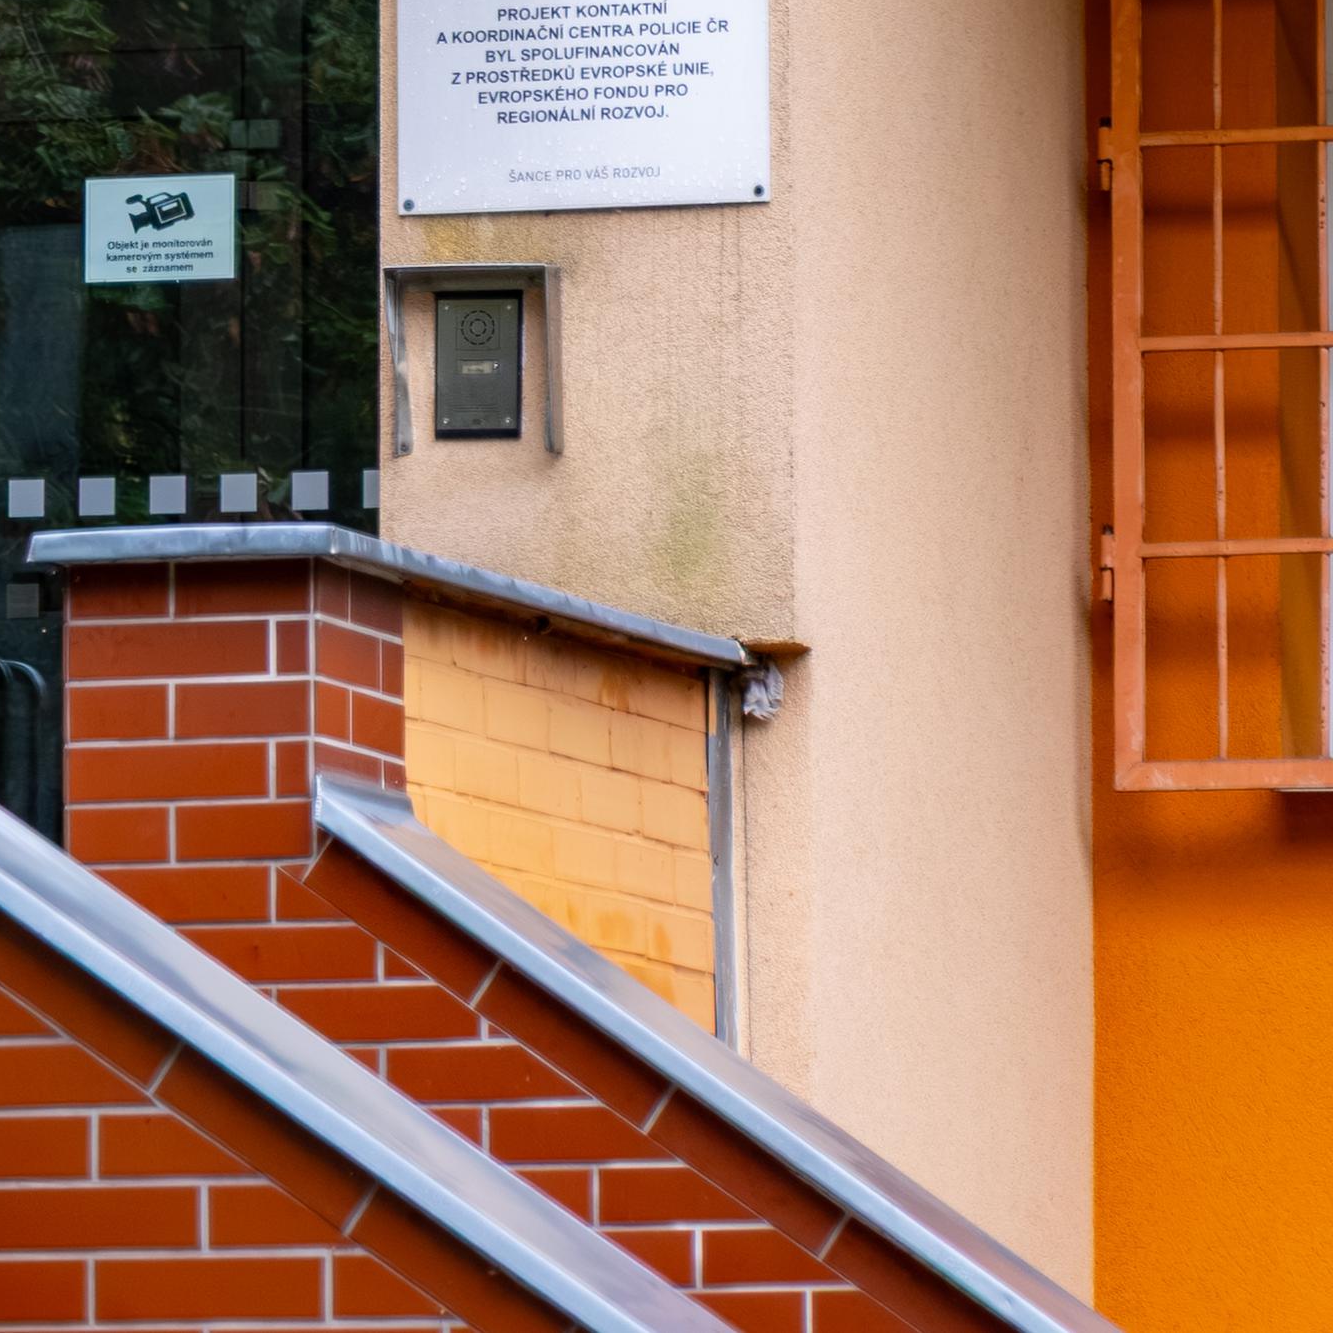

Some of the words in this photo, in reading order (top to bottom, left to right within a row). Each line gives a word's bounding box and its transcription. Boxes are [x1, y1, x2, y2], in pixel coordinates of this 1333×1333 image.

[497, 6, 571, 21] PROJEKT
[576, 0, 668, 18] KONTAKTNÍ
[436, 32, 448, 44] A
[452, 24, 564, 43] KOORDINAČNÍ
[569, 23, 633, 39] CENTRA
[639, 21, 701, 36] POLICIE
[707, 17, 729, 33] ČR
[485, 48, 516, 63] BYL
[520, 42, 680, 61] SPOLUFINANCOVÁN
[451, 72, 461, 85] Z
[466, 65, 575, 84] PROSTŘEDKŮ
[580, 64, 667, 79] EVROPSKÉ
[673, 62, 714, 77] UNIE,
[478, 86, 589, 104] EVROPSKÉHO
[594, 85, 649, 100] FONDU
[655, 84, 688, 97] PRO
[497, 105, 596, 124] REGIONÁLNÍ
[601, 105, 670, 120] ROZVOJ.
[509, 169, 552, 183] ŠANCE
[556, 169, 582, 181] PRO
[586, 167, 609, 180] VÁŠ
[613, 166, 661, 179] ROZVOJ
[107, 240, 139, 251] Objekt
[140, 240, 150, 250] je
[152, 238, 213, 249] monitorován
[106, 252, 162, 262] kamerovým
[164, 251, 214, 261] systémem
[125, 265, 138, 273] se
[142, 263, 194, 273] záznamem
